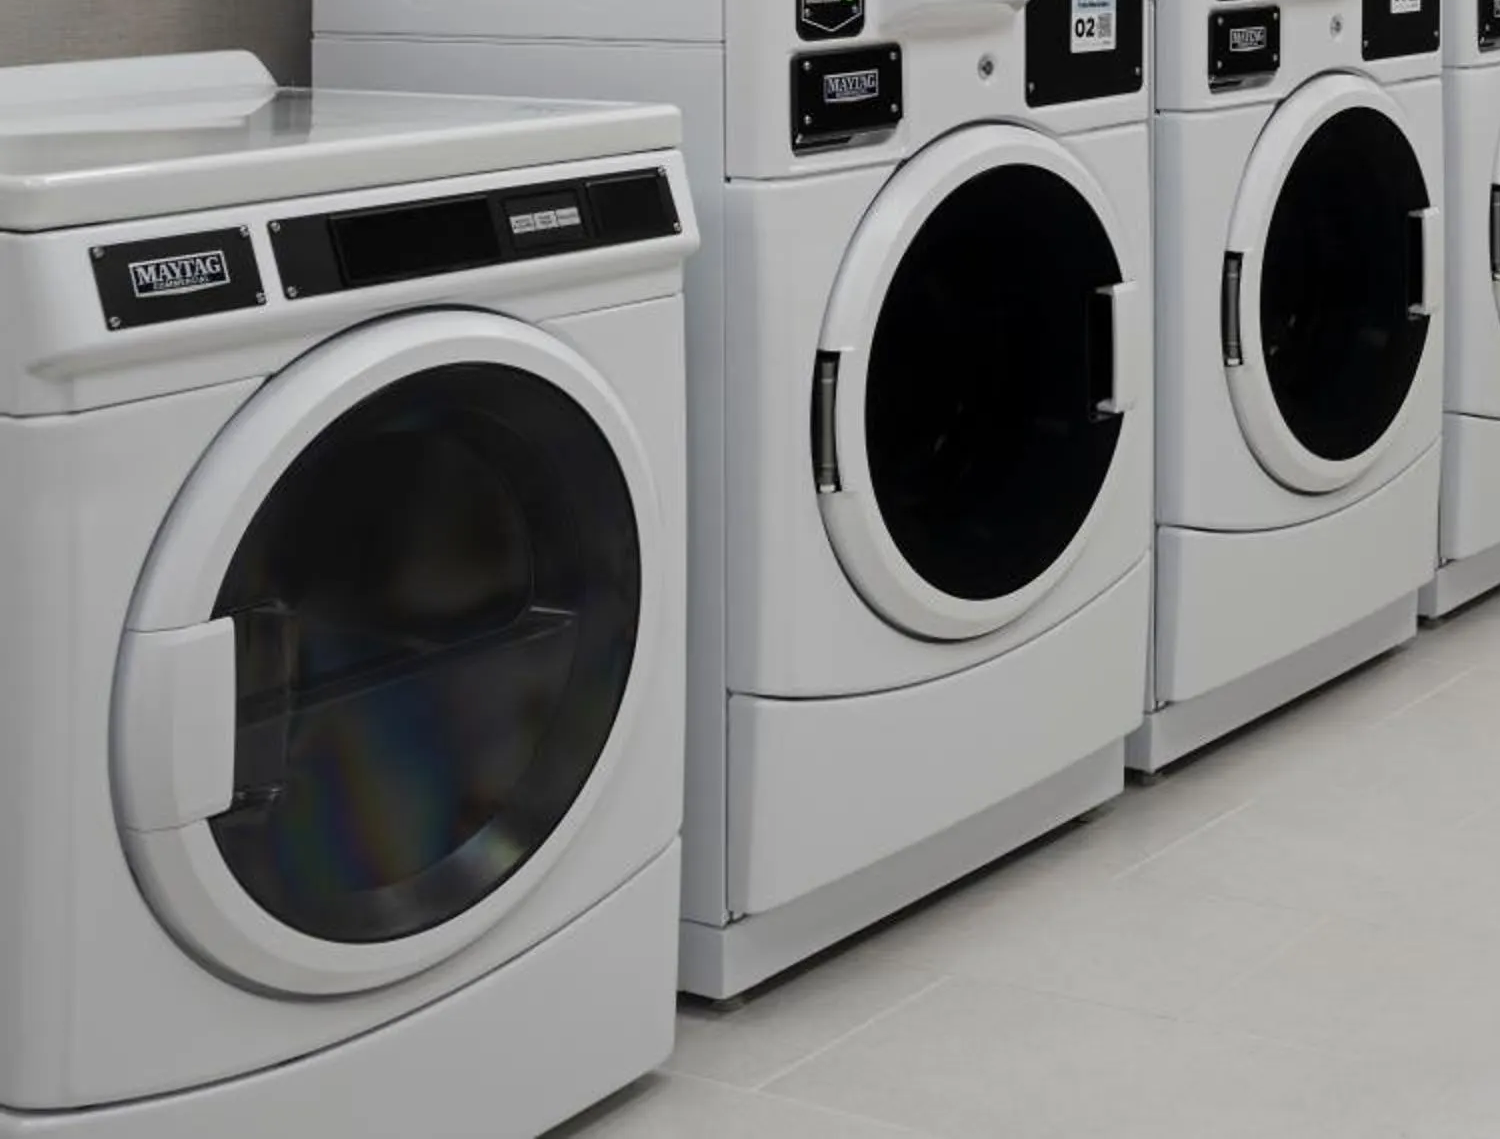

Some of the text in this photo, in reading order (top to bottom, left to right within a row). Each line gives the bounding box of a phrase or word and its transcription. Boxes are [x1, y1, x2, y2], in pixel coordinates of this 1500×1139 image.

[1075, 17, 1095, 38] 02
[827, 74, 875, 93] MAYTAG
[135, 256, 221, 286] MAYTAG
